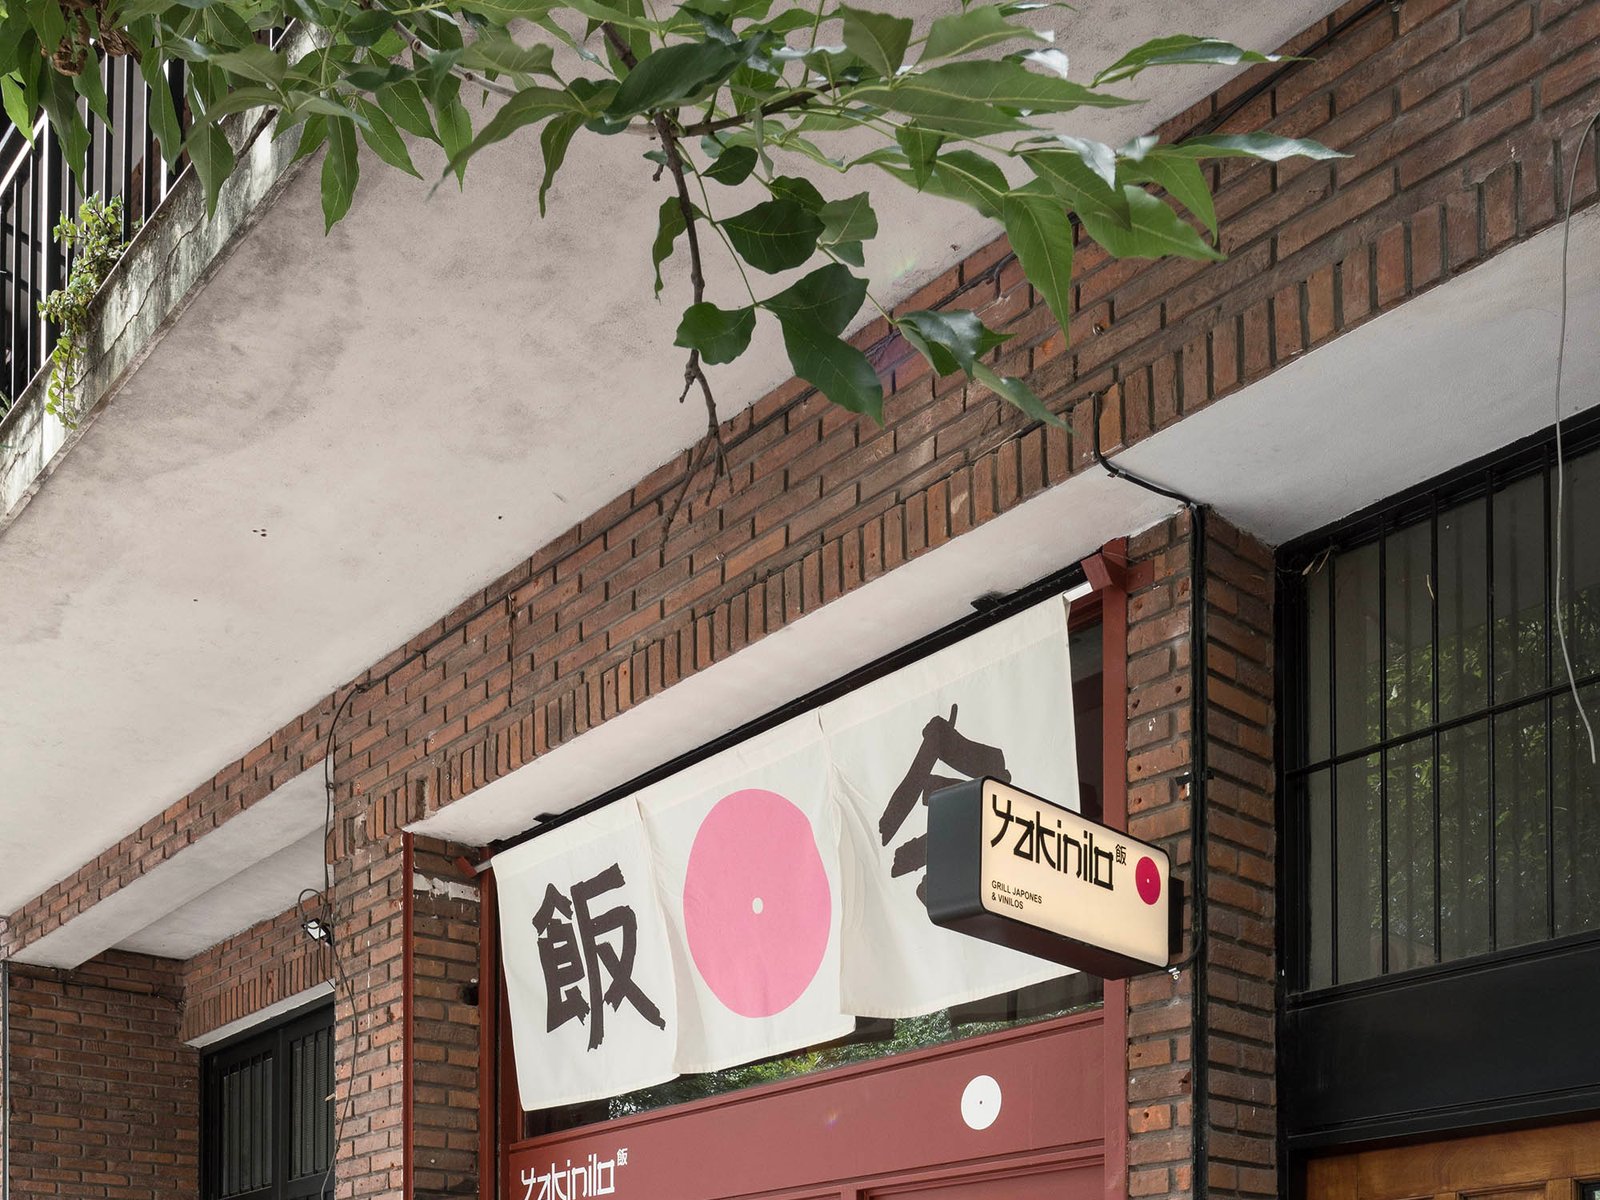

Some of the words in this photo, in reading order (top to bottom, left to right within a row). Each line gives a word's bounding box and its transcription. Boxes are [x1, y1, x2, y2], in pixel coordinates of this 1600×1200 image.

[991, 880, 1011, 894] GRILL
[1012, 887, 1043, 904] JAPONES
[991, 892, 996, 901] &
[997, 893, 1024, 910] VINILOS
[532, 863, 666, 1052] 飯
